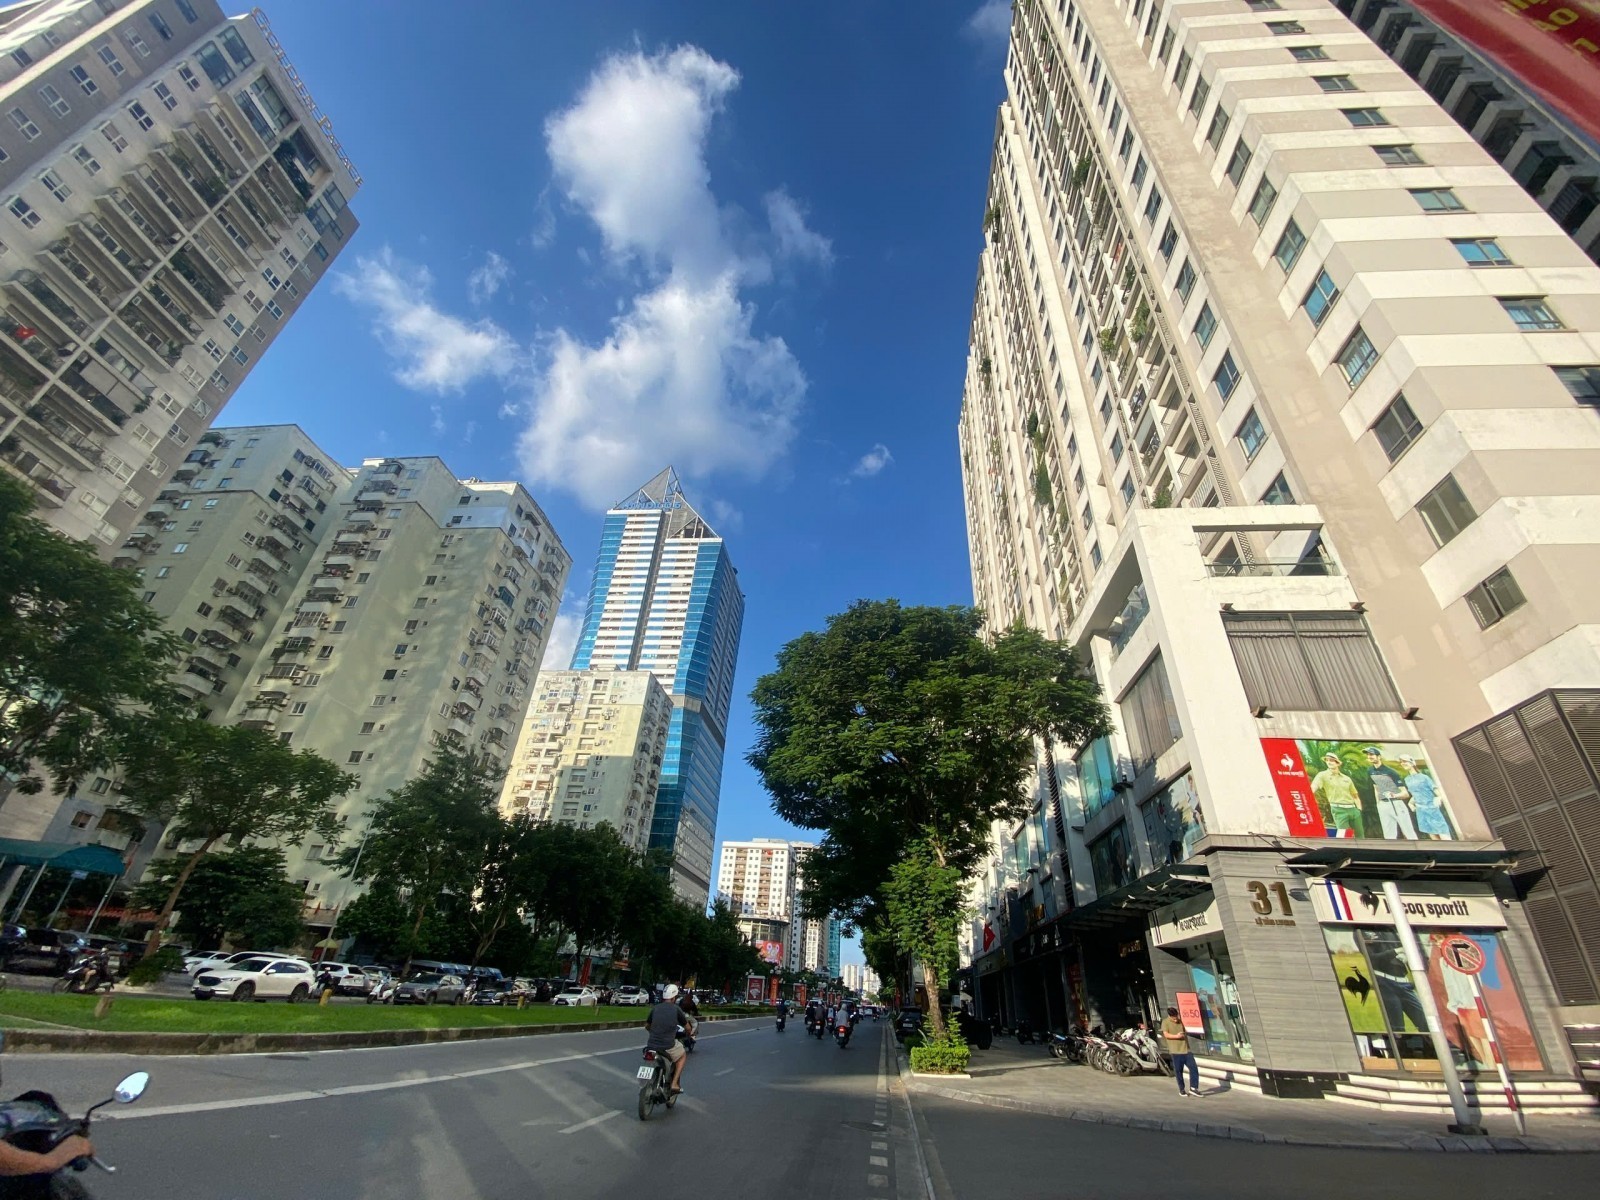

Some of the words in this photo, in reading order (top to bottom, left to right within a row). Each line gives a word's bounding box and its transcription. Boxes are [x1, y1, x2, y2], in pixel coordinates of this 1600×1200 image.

[1289, 790, 1306, 812] Midi
[1299, 812, 1309, 825] Le
[1247, 881, 1293, 916] 31
[1425, 900, 1469, 918] sportif
